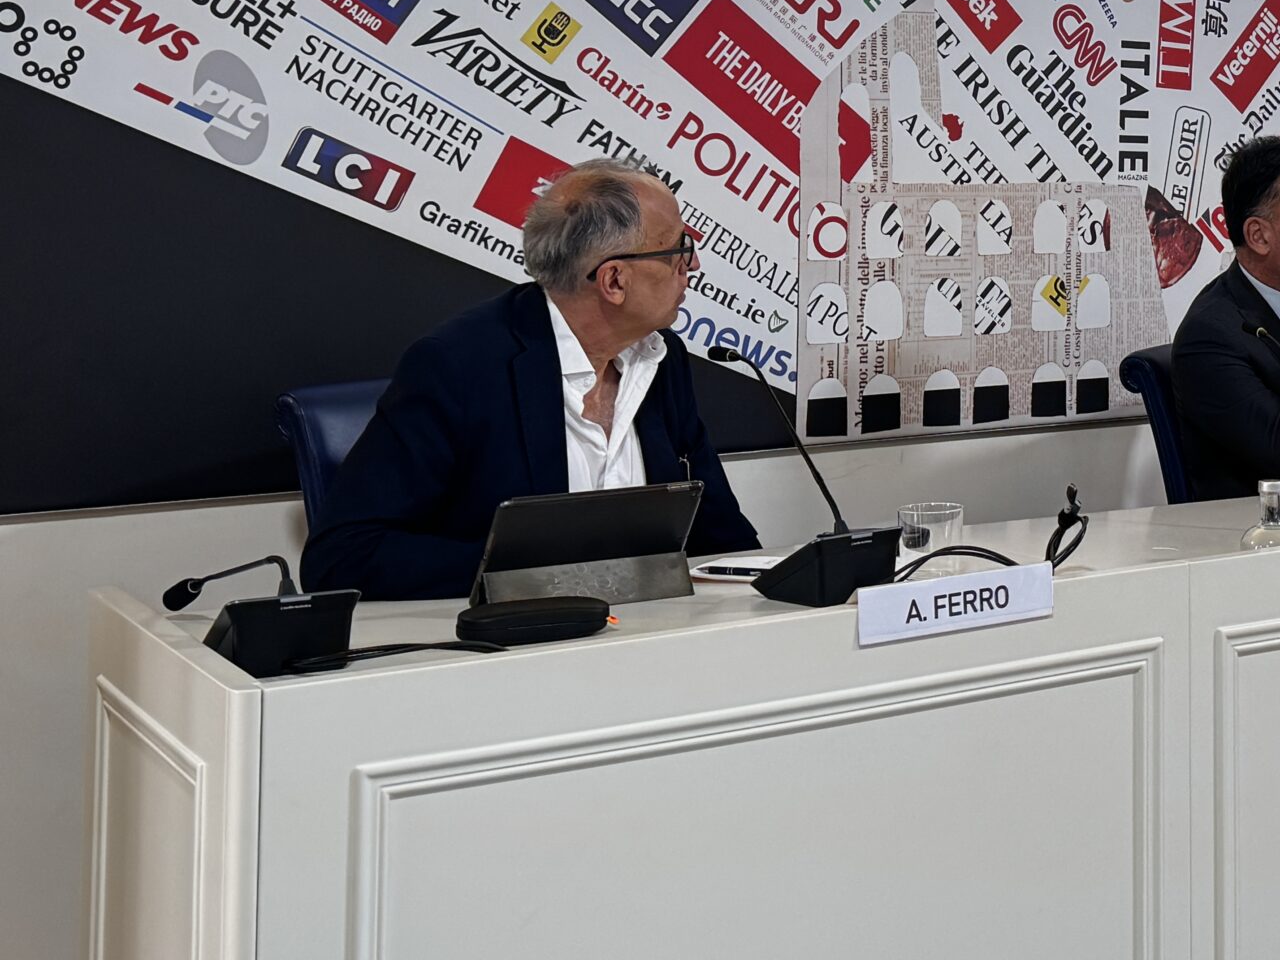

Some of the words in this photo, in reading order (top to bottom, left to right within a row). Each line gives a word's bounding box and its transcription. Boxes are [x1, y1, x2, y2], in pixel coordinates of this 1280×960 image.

[411, 7, 588, 128] VARIETY
[576, 47, 655, 120] Clarín
[1041, 50, 1087, 111] The
[1216, 6, 1279, 89] Večernji
[285, 55, 472, 172] NACHRICHTEN
[300, 35, 484, 152] STUTTGARTER
[1006, 44, 1115, 178] Guardian
[1118, 39, 1151, 172] ITALIE
[297, 133, 401, 206] LCI
[1117, 172, 1149, 181] MAGAZINE
[905, 599, 928, 624] A.
[933, 585, 1009, 619] FERRO
